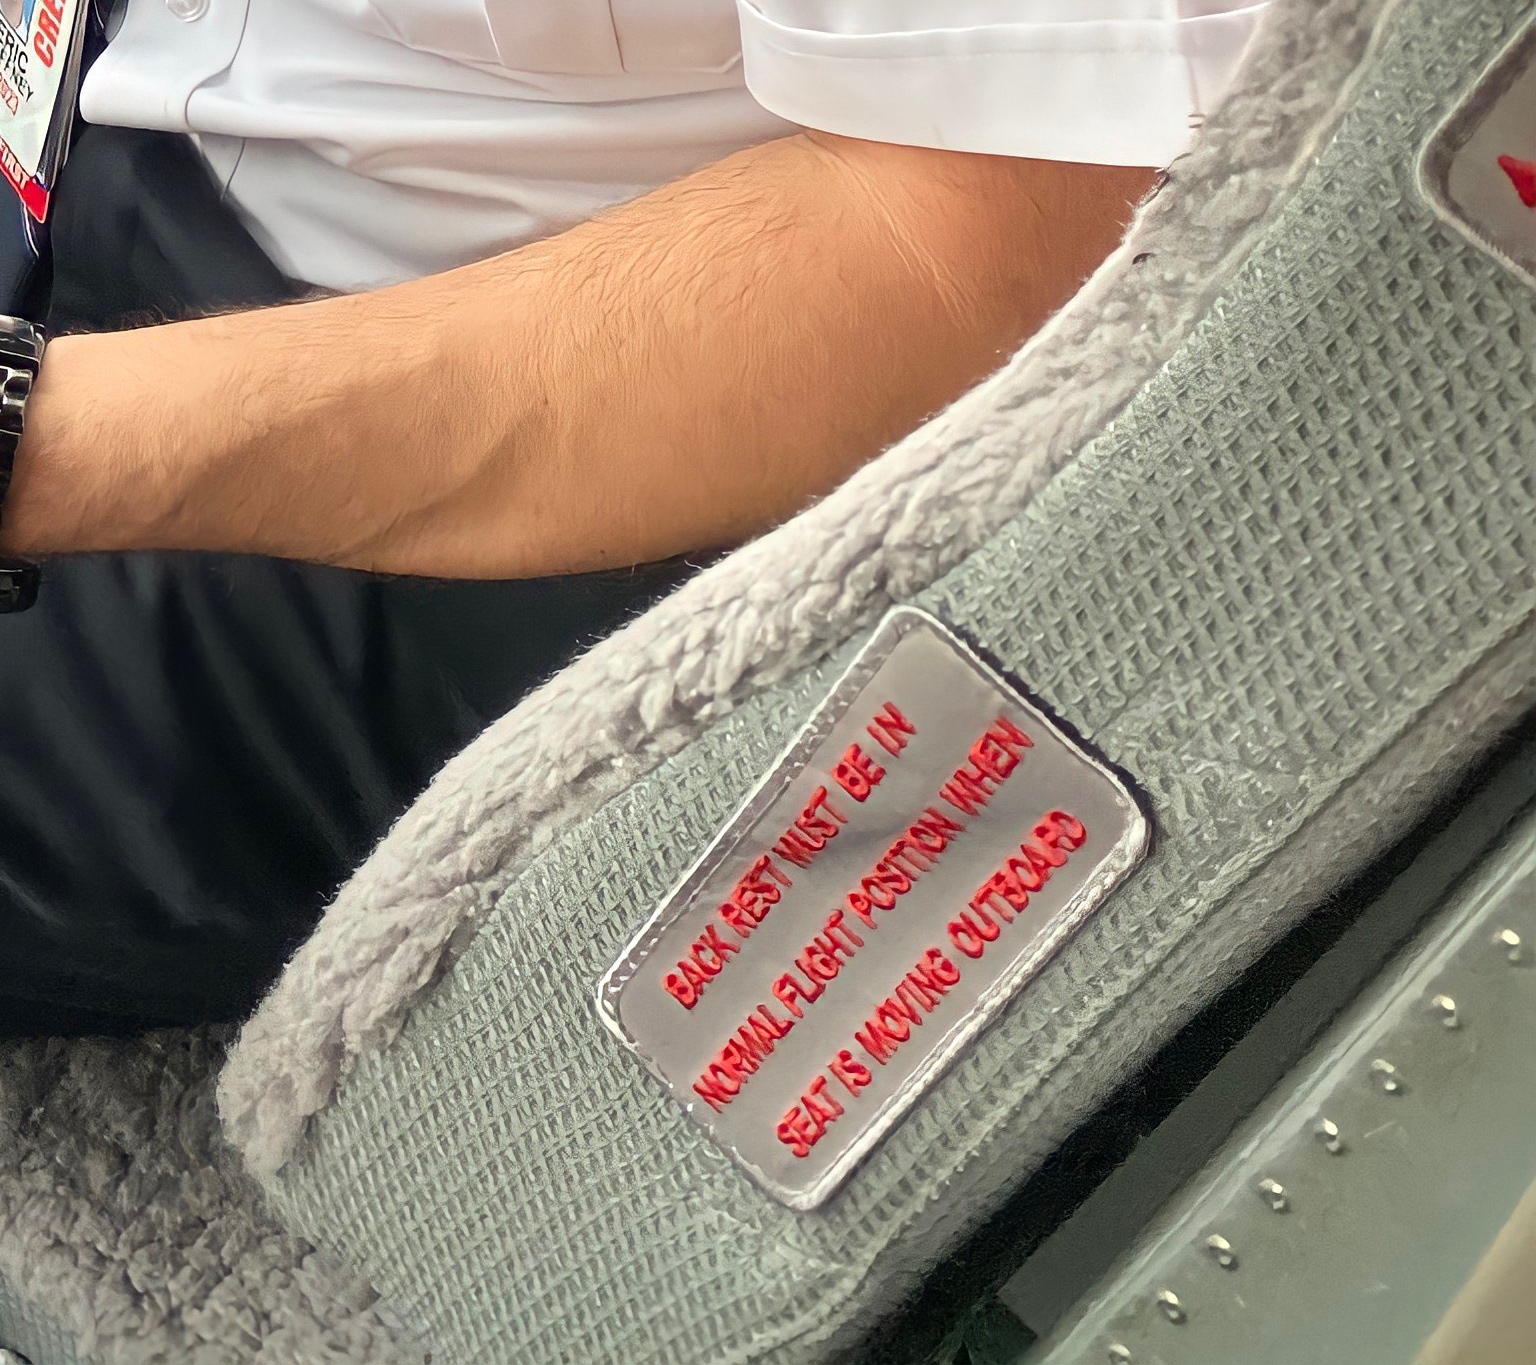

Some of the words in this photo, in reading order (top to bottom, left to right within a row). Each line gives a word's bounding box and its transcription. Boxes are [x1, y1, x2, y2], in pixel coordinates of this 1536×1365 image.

[664, 924, 741, 1010] BACK
[718, 855, 793, 939] REST
[771, 786, 848, 869] MUST
[833, 743, 887, 802] BE
[866, 701, 917, 758] IN
[692, 1004, 795, 1114] NORMAL
[771, 909, 865, 1019] FLIGHT
[847, 806, 966, 930] POSITION
[939, 715, 1035, 817] WHEN
[777, 1075, 845, 1158] SEAT
[828, 1049, 872, 1098] IS
[855, 947, 961, 1066] MOVING
[947, 810, 1087, 959] OUTBOARD
